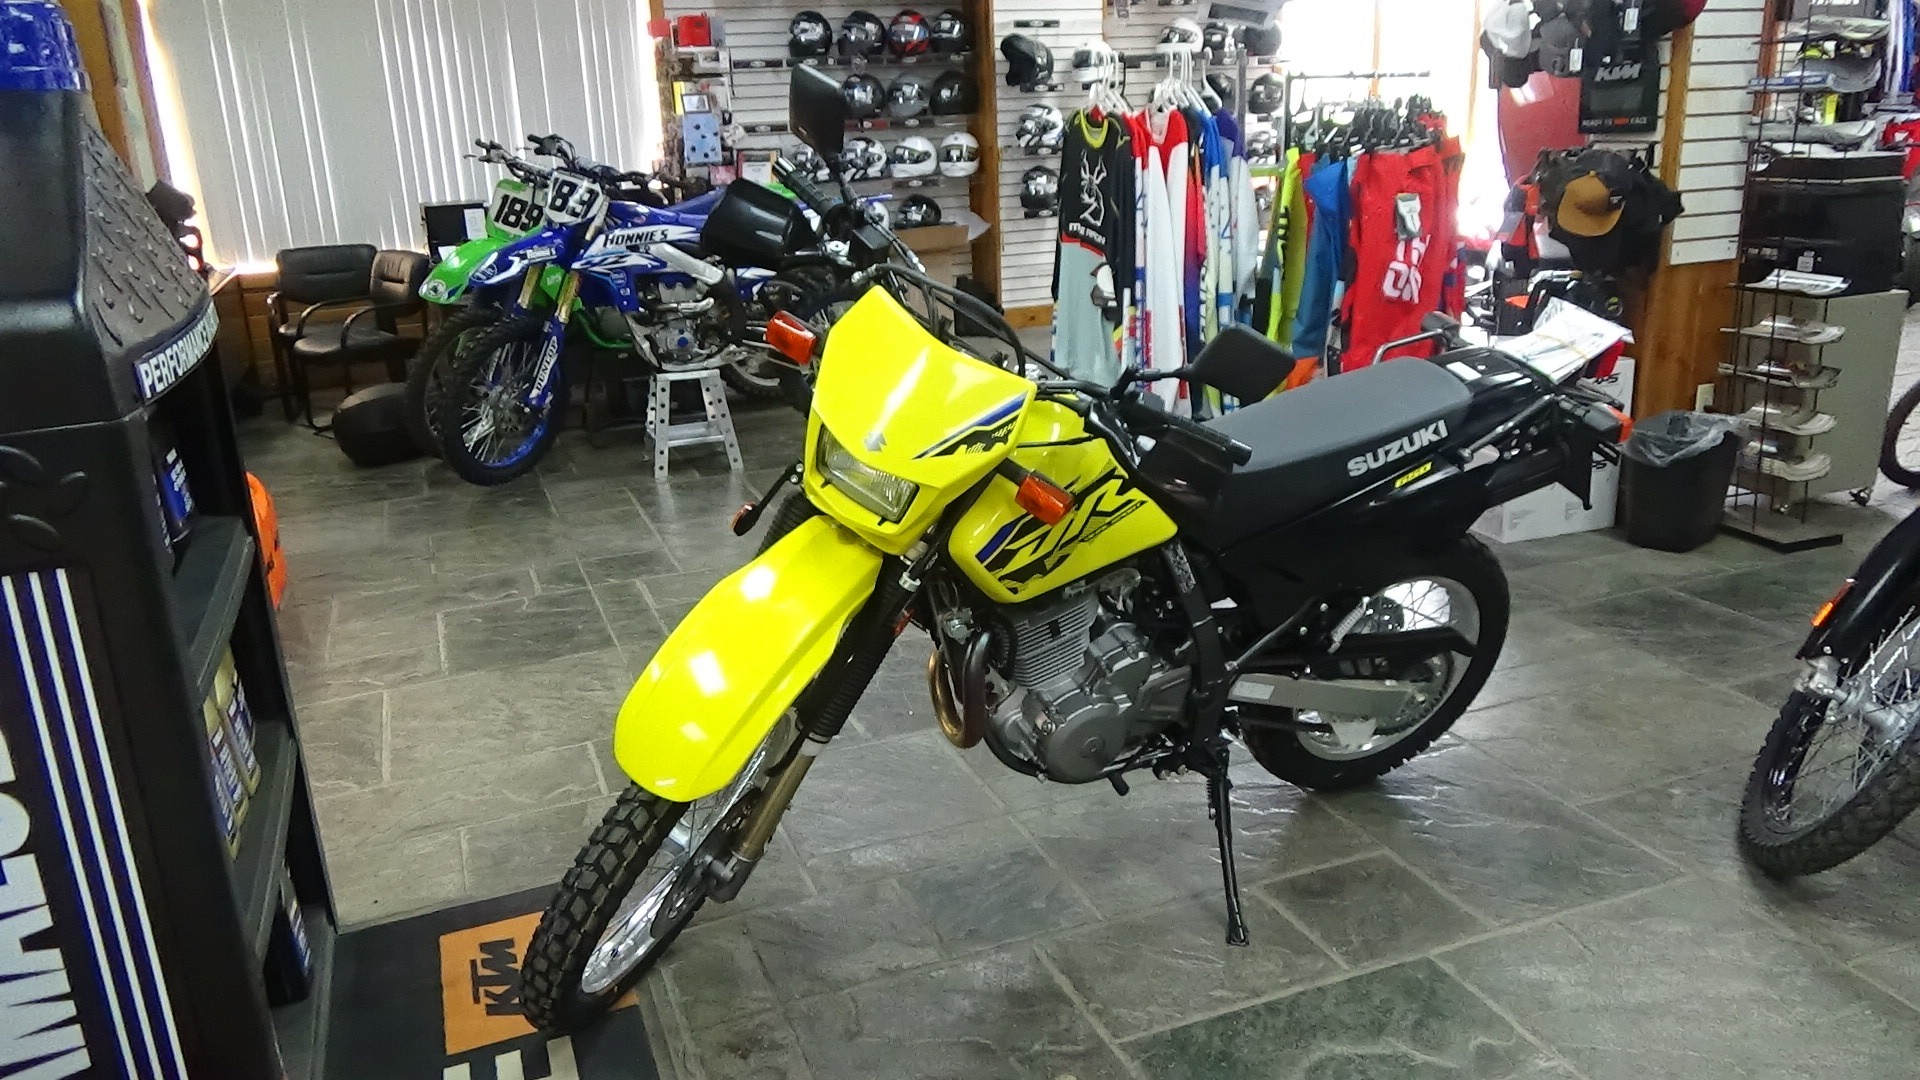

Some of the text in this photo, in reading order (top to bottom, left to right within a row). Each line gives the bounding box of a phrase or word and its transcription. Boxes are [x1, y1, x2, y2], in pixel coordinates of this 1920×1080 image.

[1594, 61, 1641, 82] KTM
[493, 193, 544, 233] 189
[534, 337, 560, 393] DUNLOP
[1347, 419, 1449, 477] SUZUKI
[469, 937, 524, 1017] KTM
